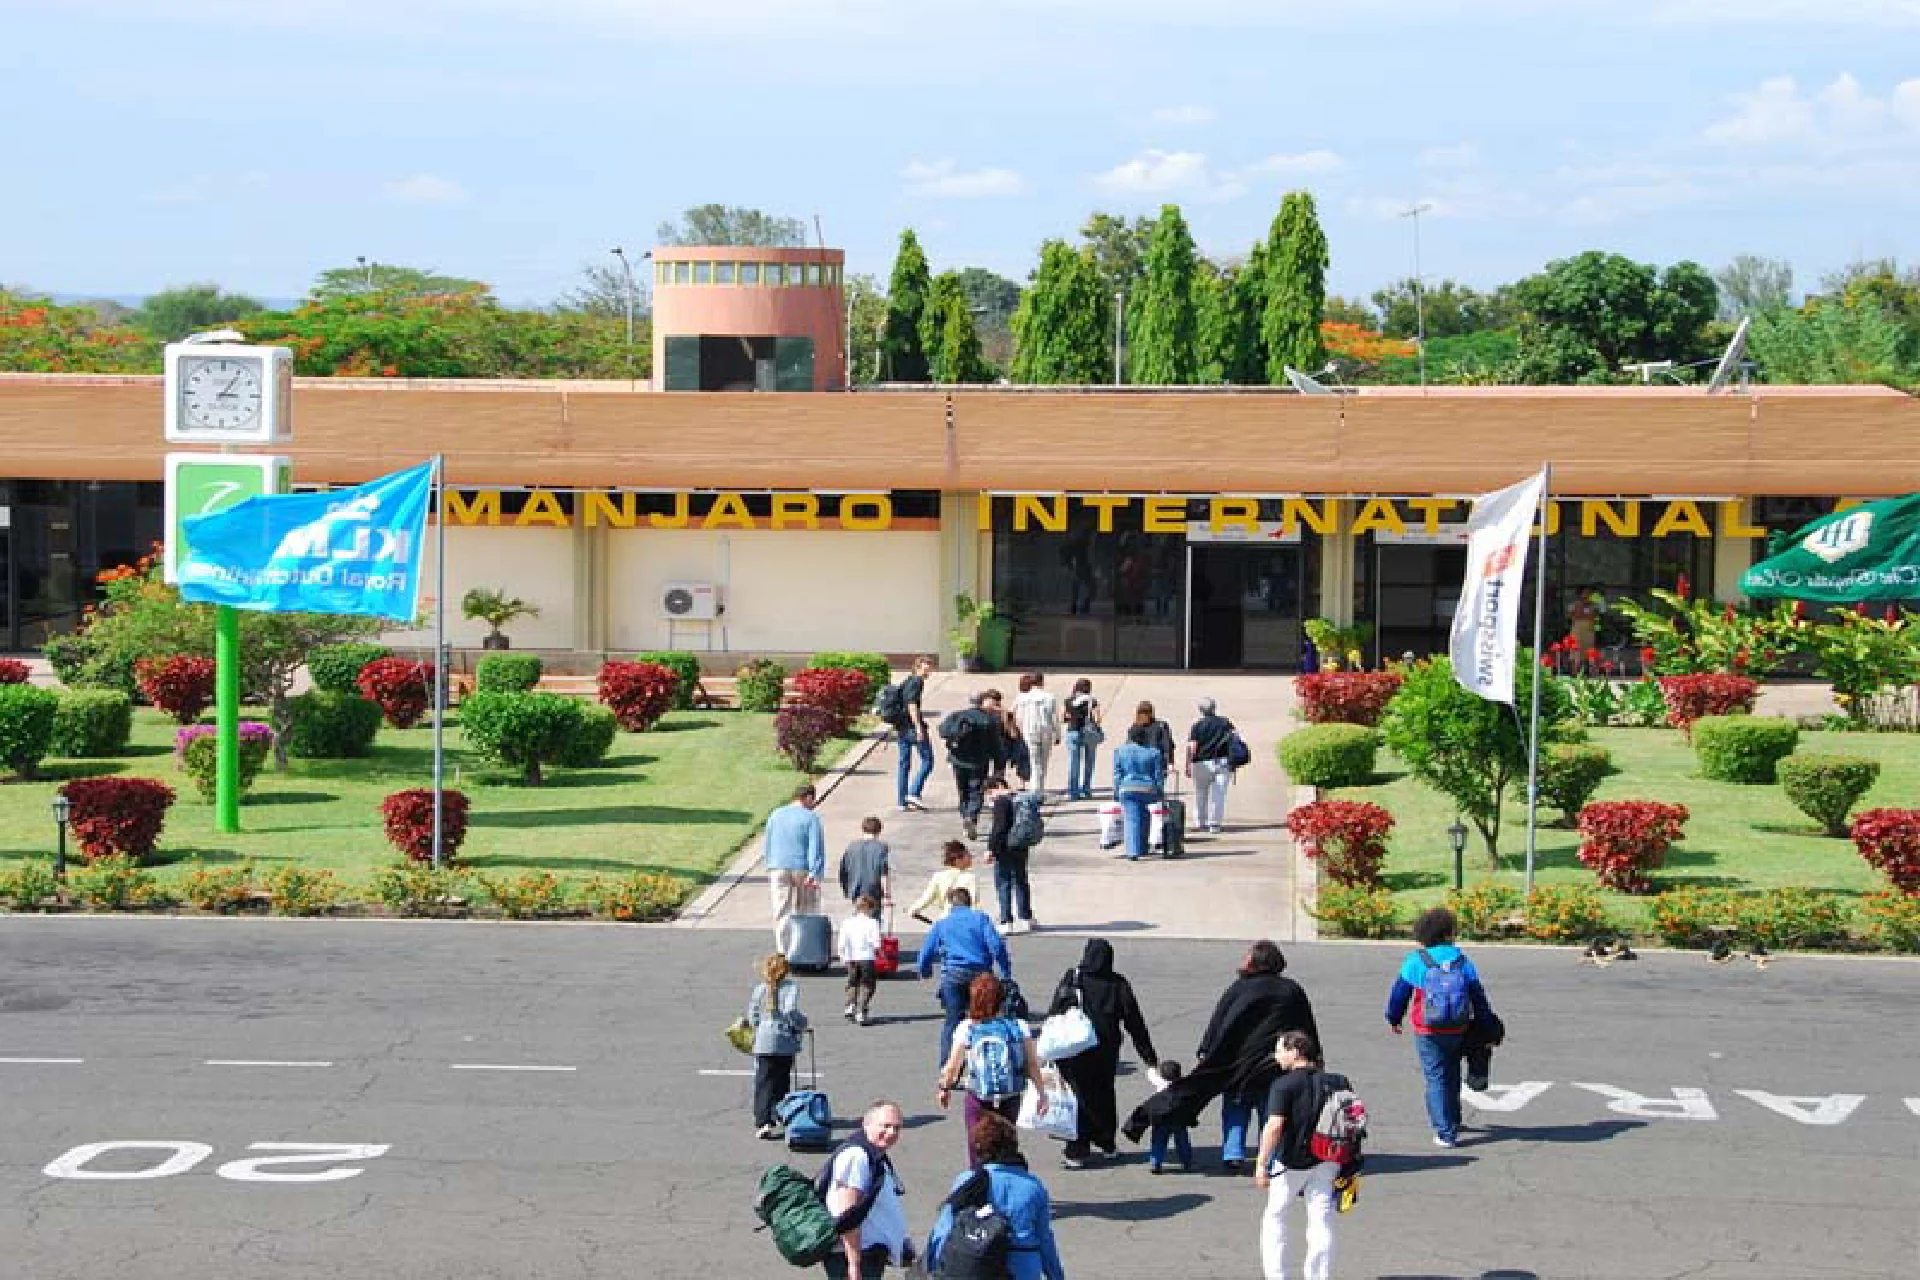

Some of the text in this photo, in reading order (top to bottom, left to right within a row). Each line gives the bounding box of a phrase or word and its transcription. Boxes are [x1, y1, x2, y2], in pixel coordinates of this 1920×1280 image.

[442, 489, 892, 530] MANJARO
[979, 493, 1767, 538] INTERNATNAL
[1460, 1080, 1920, 1125] ARA
